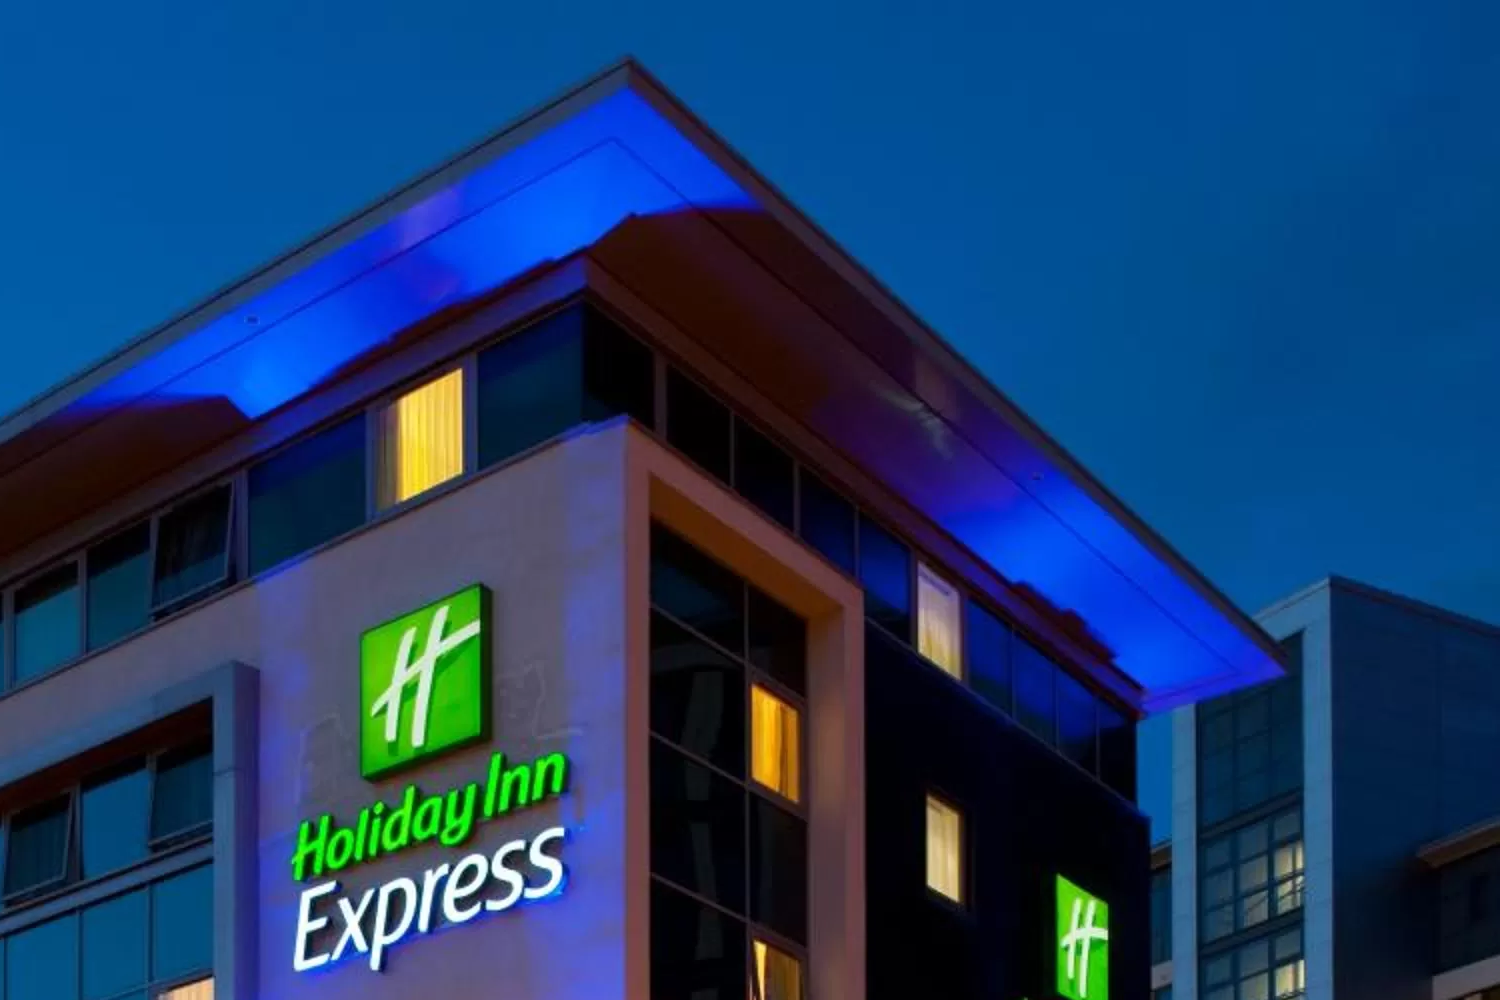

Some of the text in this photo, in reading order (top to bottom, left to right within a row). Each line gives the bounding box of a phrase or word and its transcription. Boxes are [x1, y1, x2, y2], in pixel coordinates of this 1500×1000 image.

[372, 605, 481, 748] H
[291, 751, 569, 881] Holiday Inn
[292, 826, 567, 973] Express
